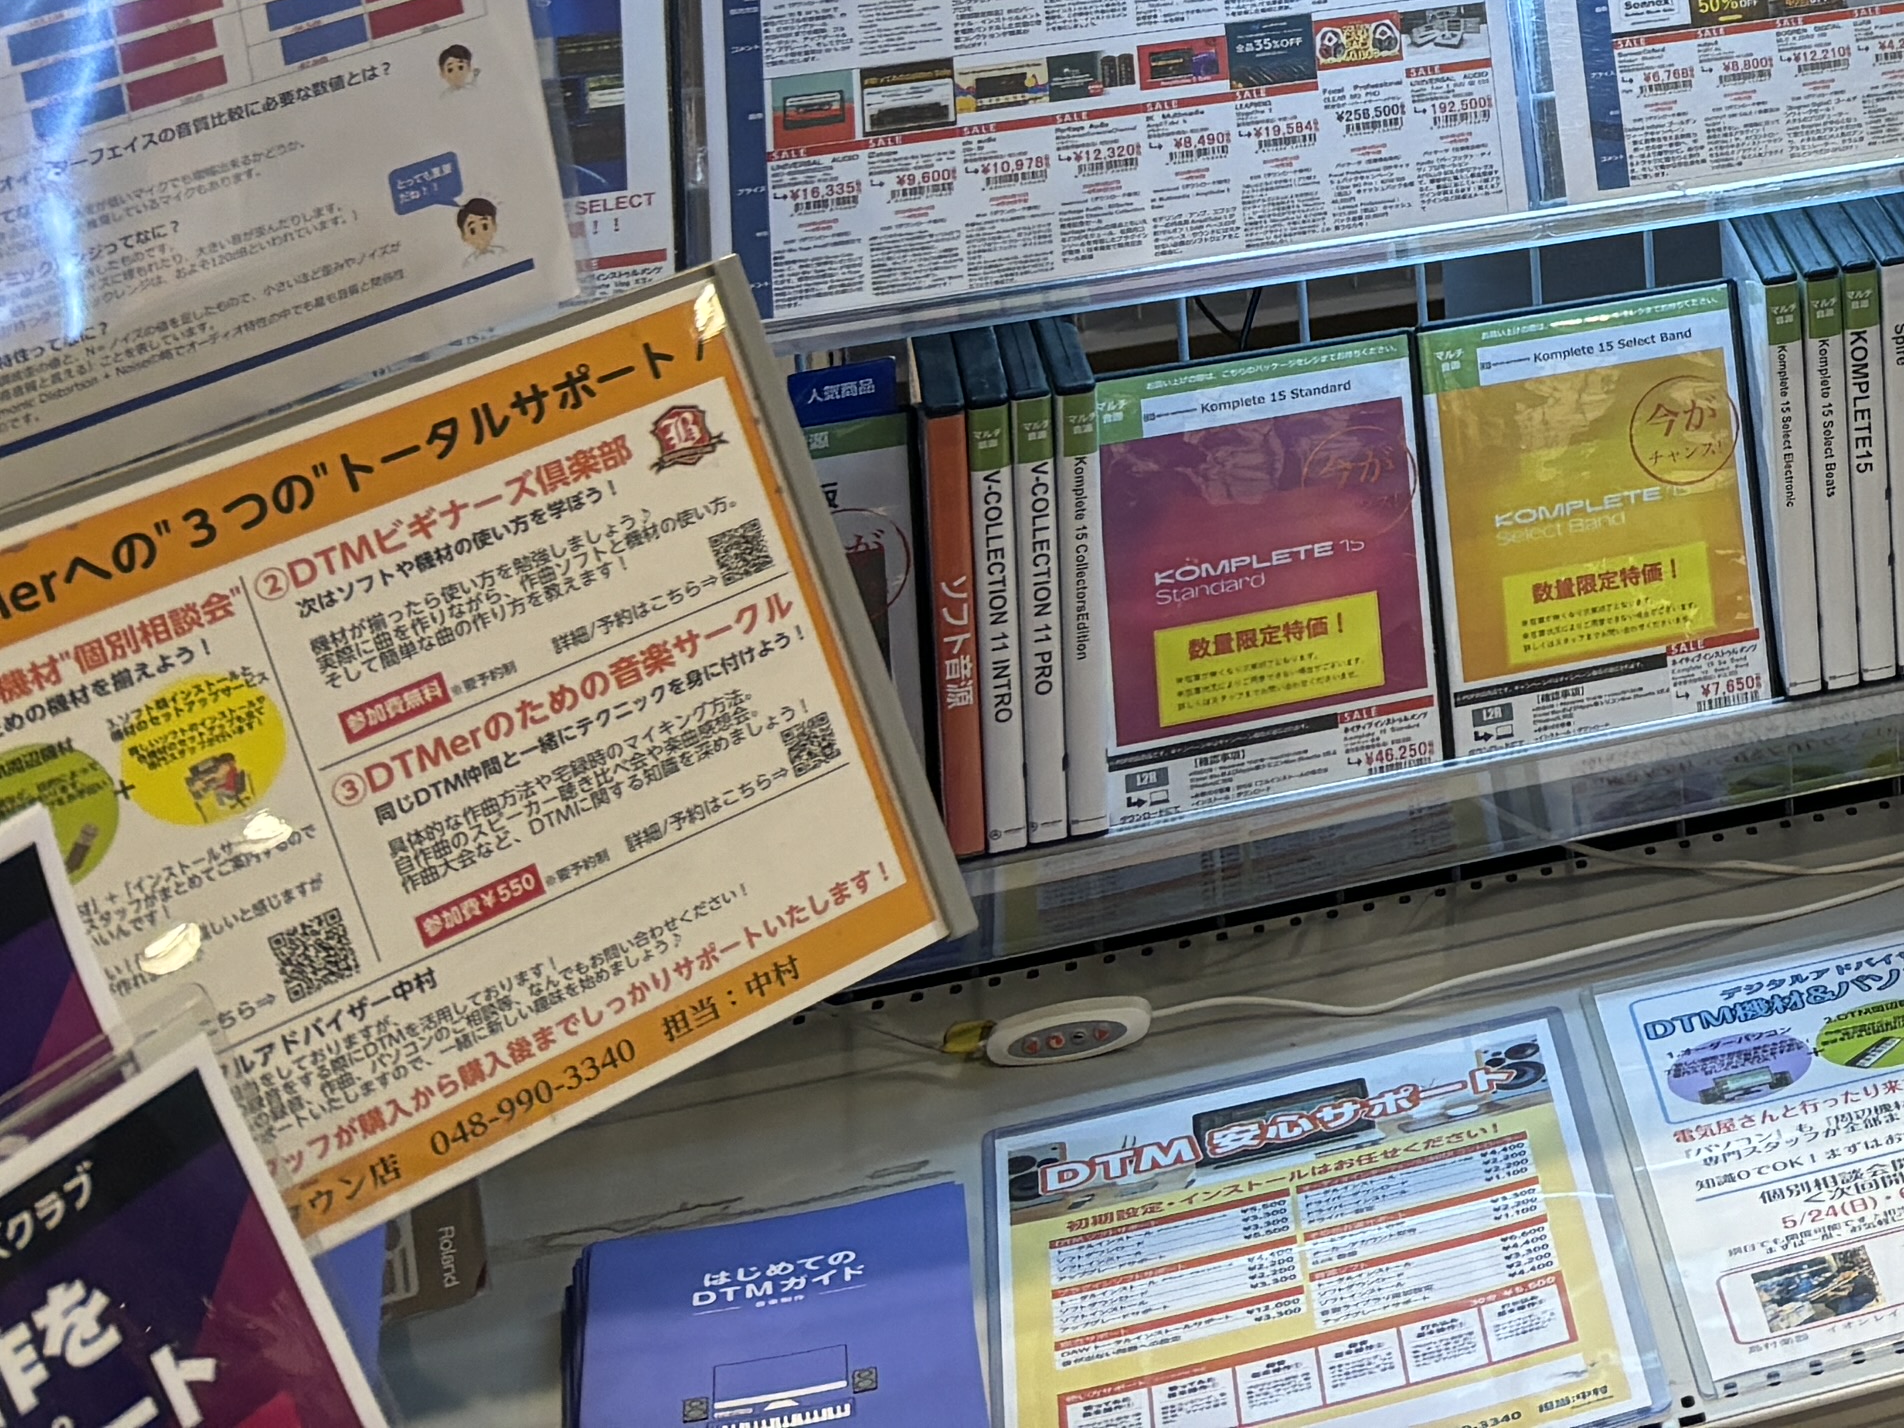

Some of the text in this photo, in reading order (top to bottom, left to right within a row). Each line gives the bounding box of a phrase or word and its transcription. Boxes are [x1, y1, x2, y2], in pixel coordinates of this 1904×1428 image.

[1494, 486, 1663, 530] KOMPLETE
[296, 482, 620, 620] 次はソフトや機材の使い方を学ぼう！
[1153, 541, 1335, 585] KOMPLETE
[1531, 557, 1678, 605] 数量限定特価！
[940, 575, 975, 709] ソフト音源
[1187, 612, 1346, 662] 数量限定特価！
[431, 1036, 637, 1158] 048-990-3340
[1038, 1066, 1517, 1198] DTM 安心サポート
[692, 1264, 866, 1306] DTMガイド
[702, 1248, 856, 1289] はじめての
